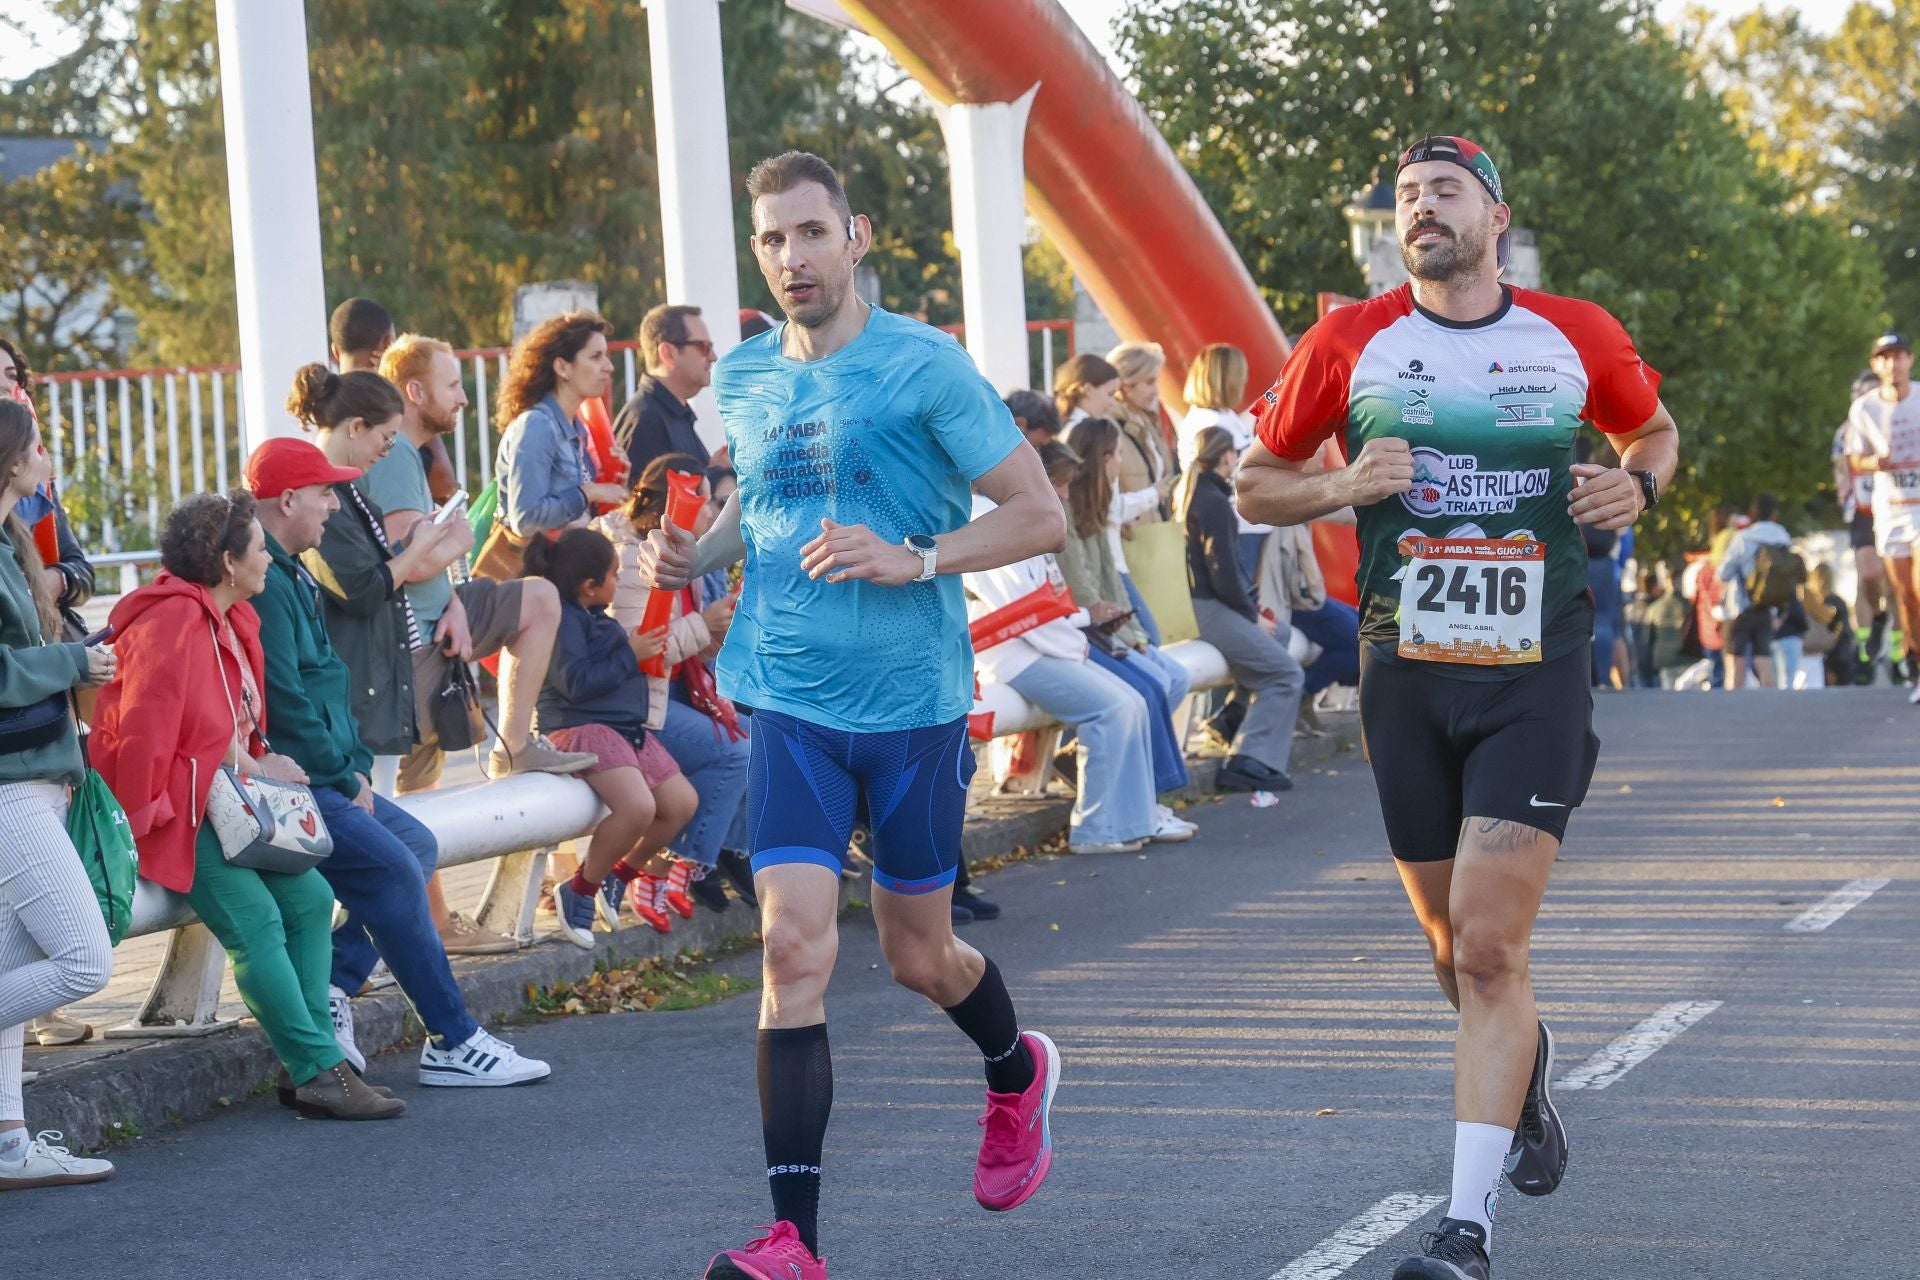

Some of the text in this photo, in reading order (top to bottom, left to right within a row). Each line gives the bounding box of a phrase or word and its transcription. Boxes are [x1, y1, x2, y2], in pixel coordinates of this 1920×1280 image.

[1398, 371, 1436, 383] VIATOR
[786, 421, 827, 440] MBA
[779, 442, 830, 462] media
[1446, 498, 1513, 513] TRIATLON
[1443, 545, 1473, 554] MBA
[1496, 545, 1523, 556] GIJÓN
[1416, 564, 1527, 616] 2416
[1448, 623, 1495, 632] ANGEL ABRIL
